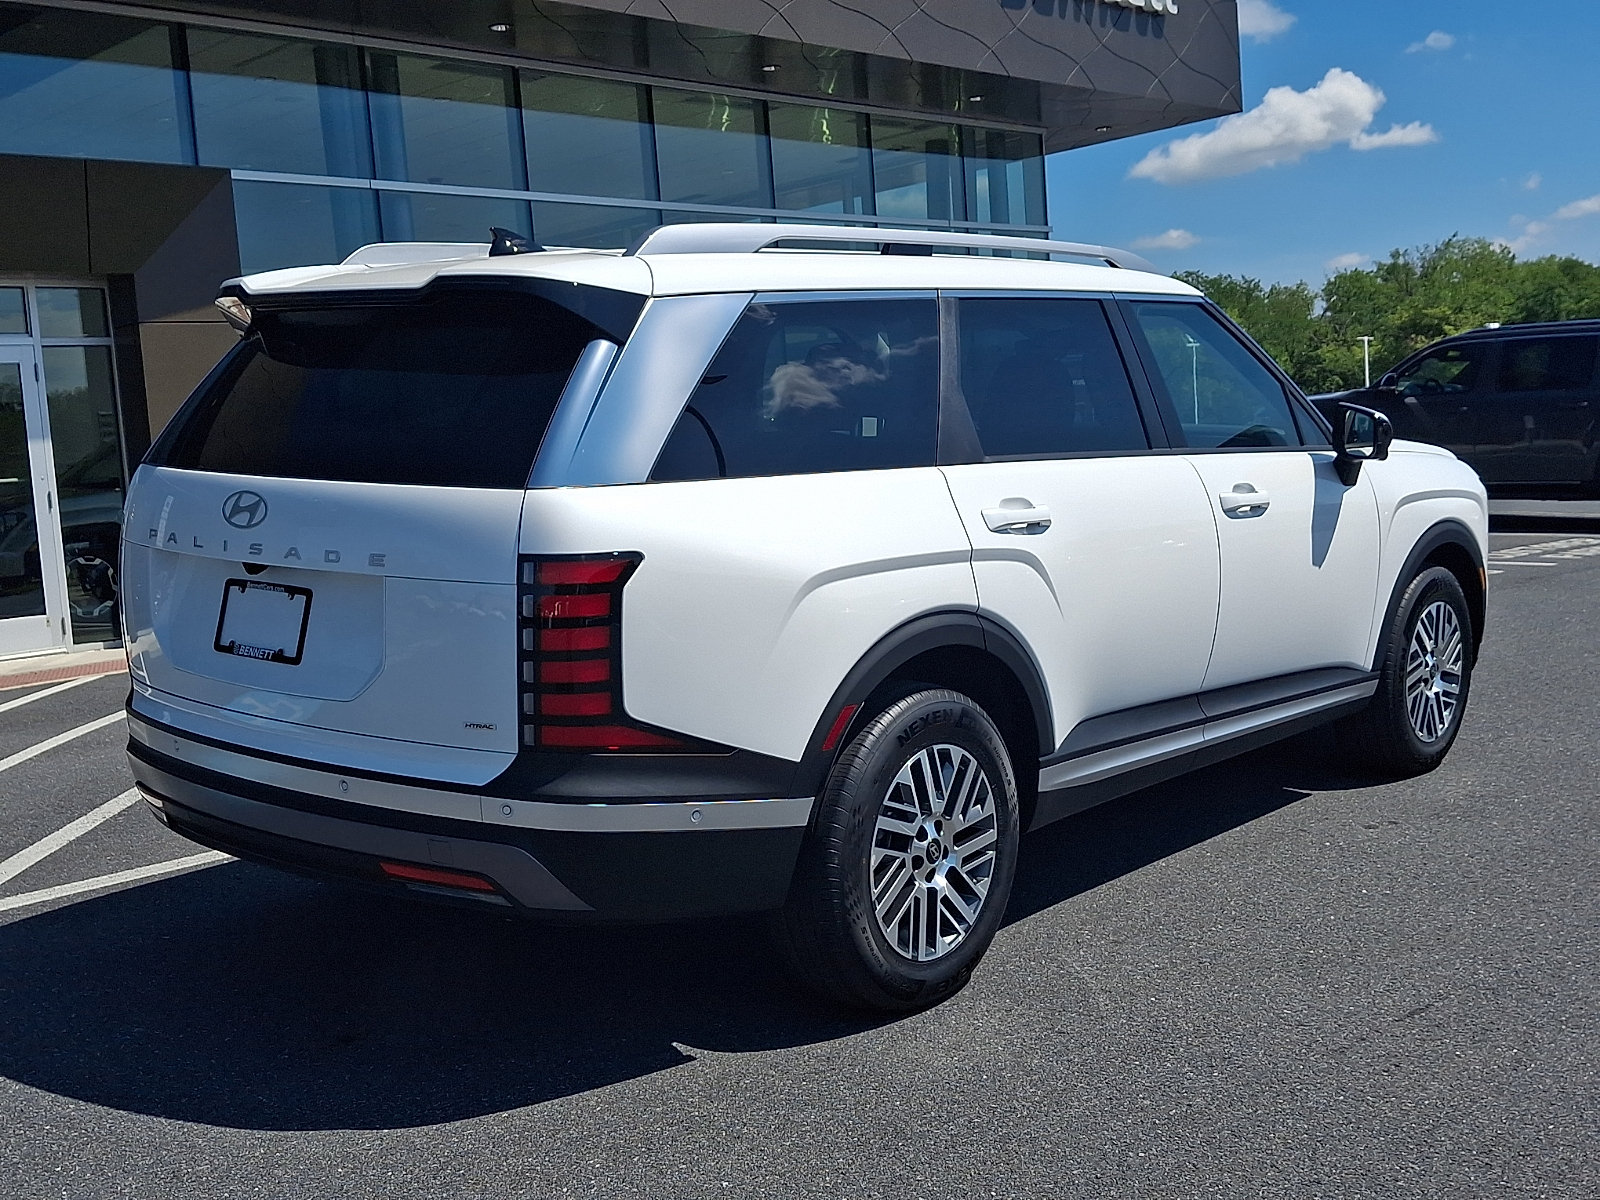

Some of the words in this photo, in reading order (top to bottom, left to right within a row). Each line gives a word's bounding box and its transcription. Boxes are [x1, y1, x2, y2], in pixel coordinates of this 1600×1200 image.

[148, 528, 387, 568] PALISADE
[238, 645, 275, 660] BENNETT
[464, 722, 494, 730] HTRAC
[896, 709, 953, 748] NEXEN
